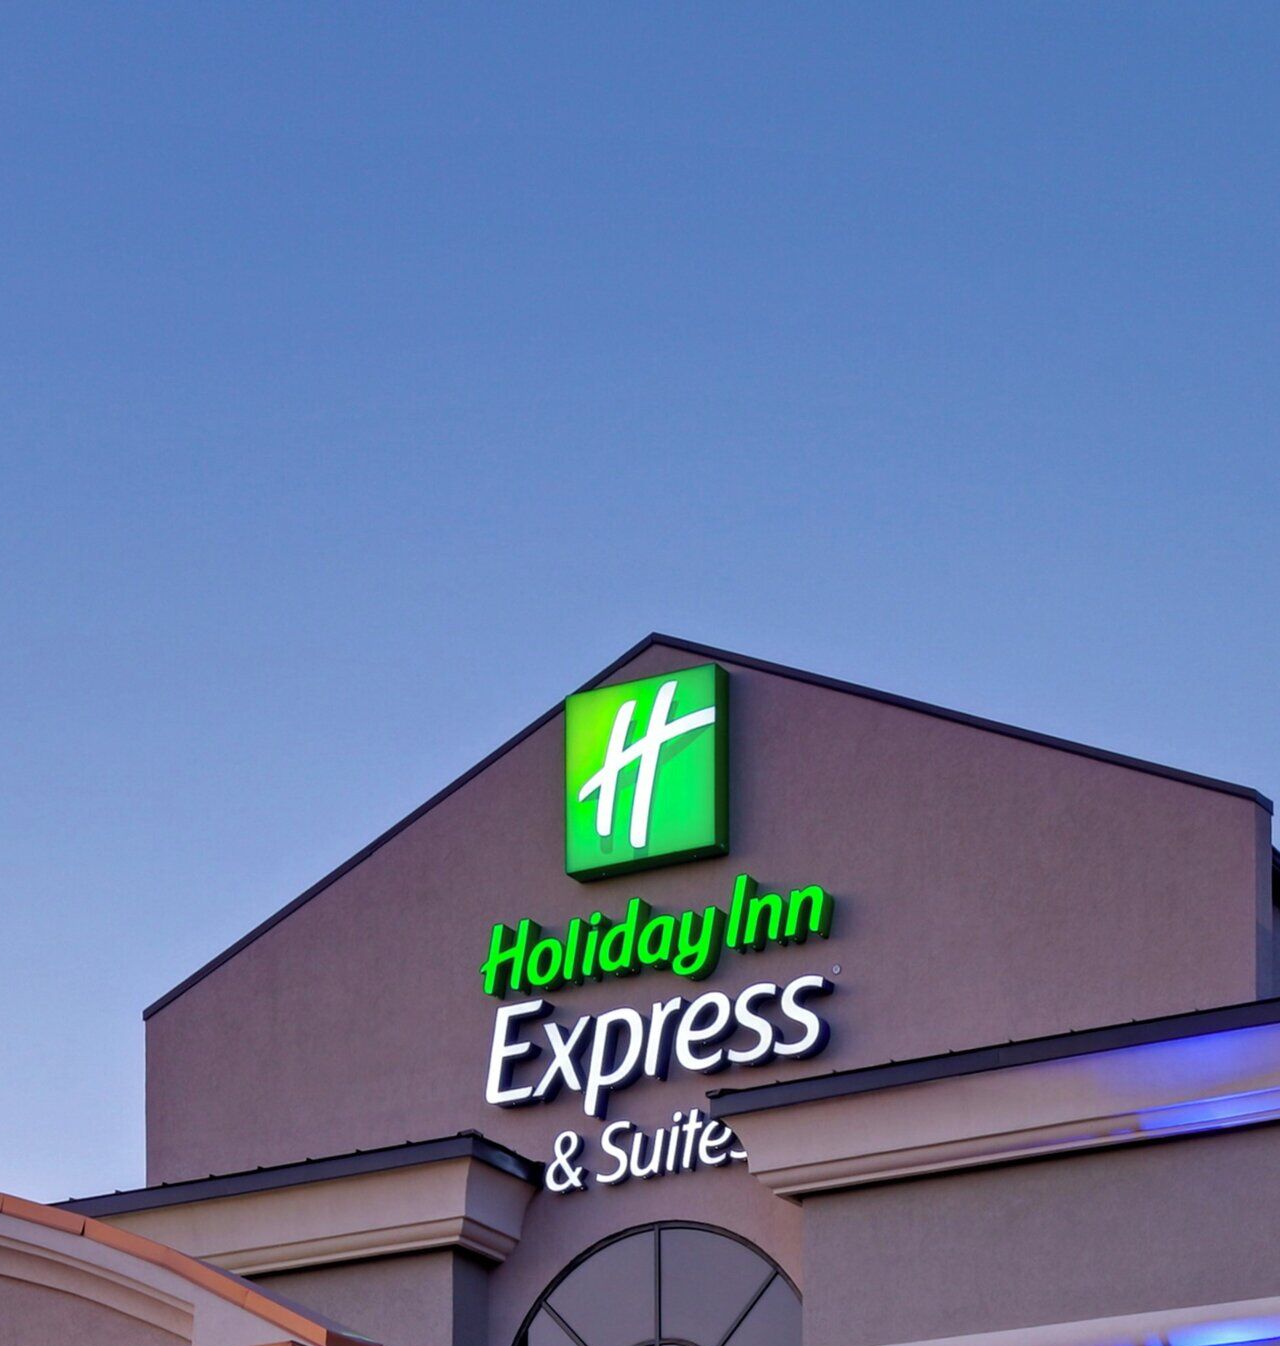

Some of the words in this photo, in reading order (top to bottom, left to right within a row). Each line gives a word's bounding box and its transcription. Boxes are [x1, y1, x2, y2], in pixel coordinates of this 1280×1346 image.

[579, 682, 716, 848] H
[481, 898, 717, 994] Holiday
[726, 874, 824, 947] Inn
[485, 975, 824, 1116] Express
[545, 1130, 583, 1192] &
[596, 1108, 748, 1183] Suite
